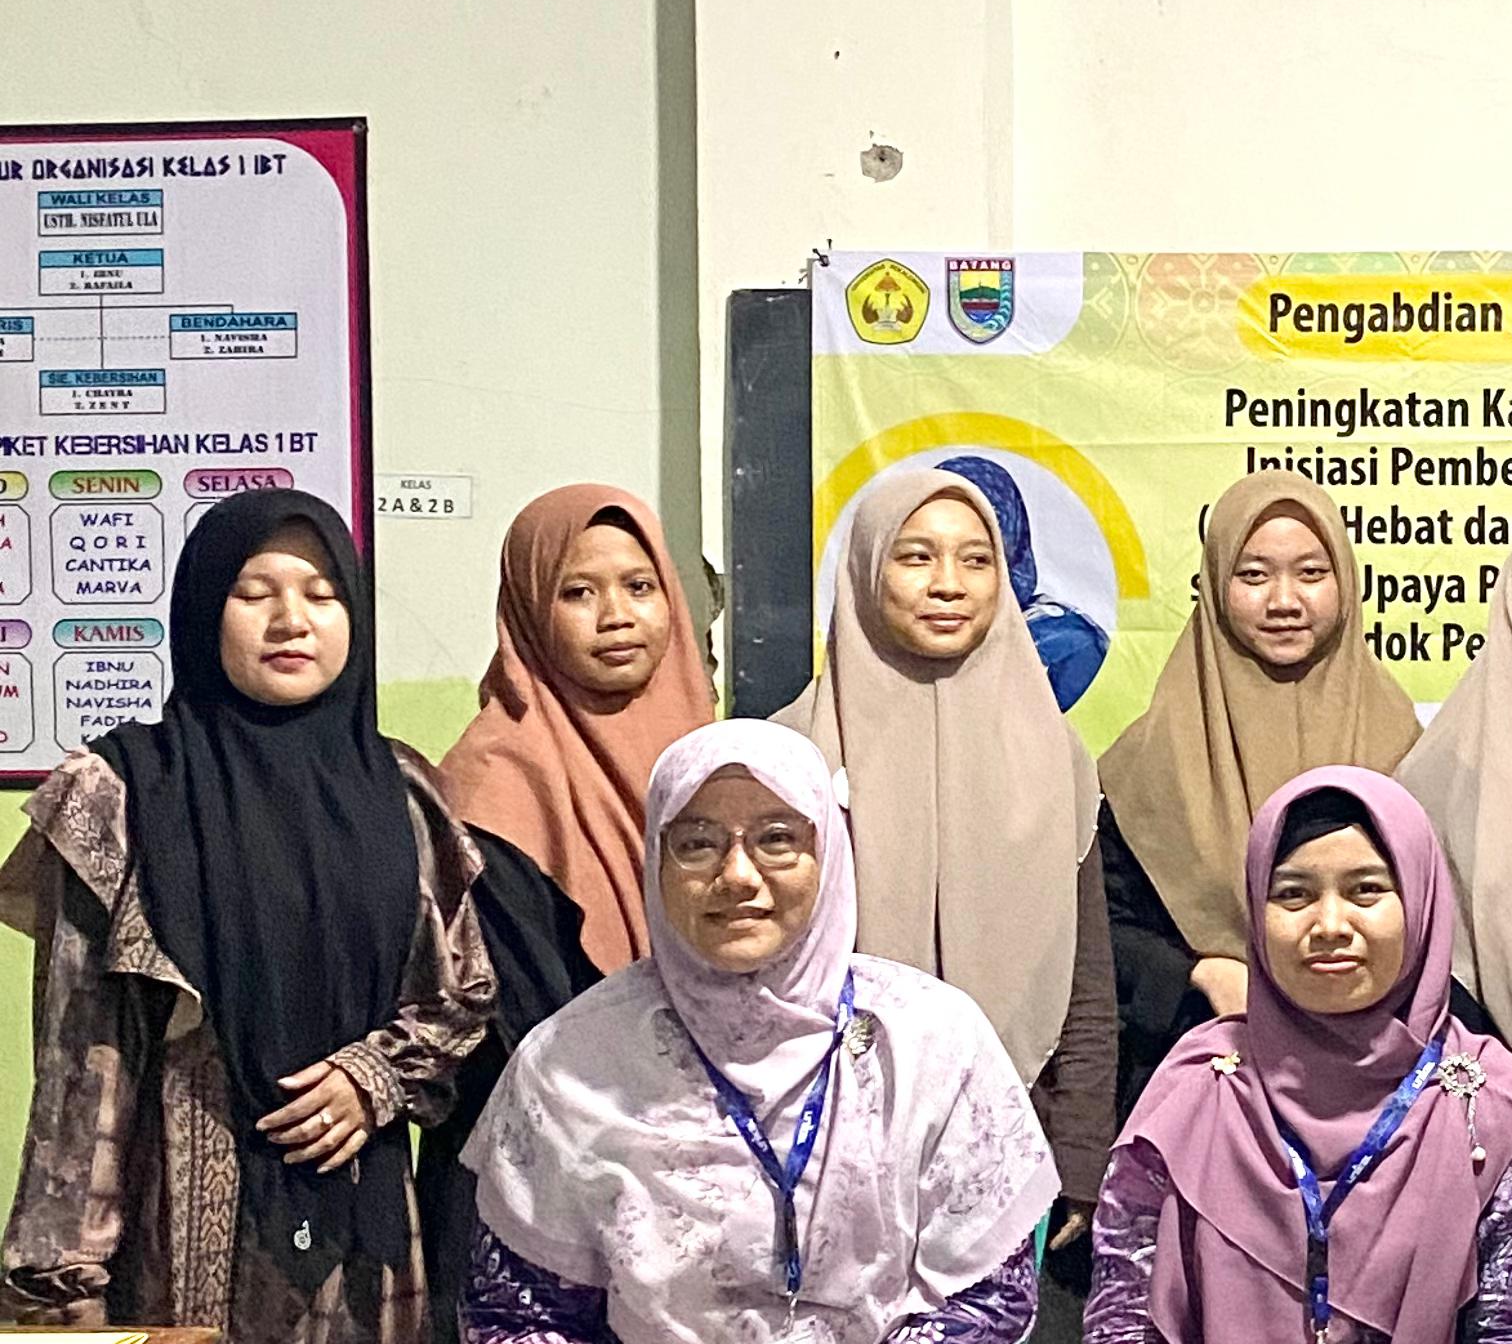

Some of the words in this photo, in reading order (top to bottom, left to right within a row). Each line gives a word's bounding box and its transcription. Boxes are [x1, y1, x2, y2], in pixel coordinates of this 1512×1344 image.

[32, 156, 154, 180] ORGANISASI
[163, 154, 230, 177] KELAS
[50, 193, 92, 205] WALI
[96, 192, 151, 205] KELAS
[73, 253, 129, 264] KETUA
[950, 260, 1012, 271] BATANG
[181, 316, 288, 329] BENDAHARA
[1269, 291, 1502, 344] Pengabdian
[75, 371, 158, 384] KEBERSIHAN
[1225, 387, 1470, 438] Peningkatan
[55, 434, 189, 456] KEBERSIHAN
[196, 433, 268, 454] KELAS
[72, 477, 141, 494] SENIN
[198, 475, 277, 492] SELASA
[400, 479, 432, 490] KELAS
[80, 513, 133, 526] WAFI
[1340, 504, 1454, 545] Hebat
[65, 559, 152, 573] CANTIKA
[76, 581, 142, 594] MARVA
[73, 624, 145, 642] KAMIS
[86, 661, 135, 673] IBNU
[66, 680, 153, 691] NADHIRA
[66, 697, 153, 709] NAVISHA
